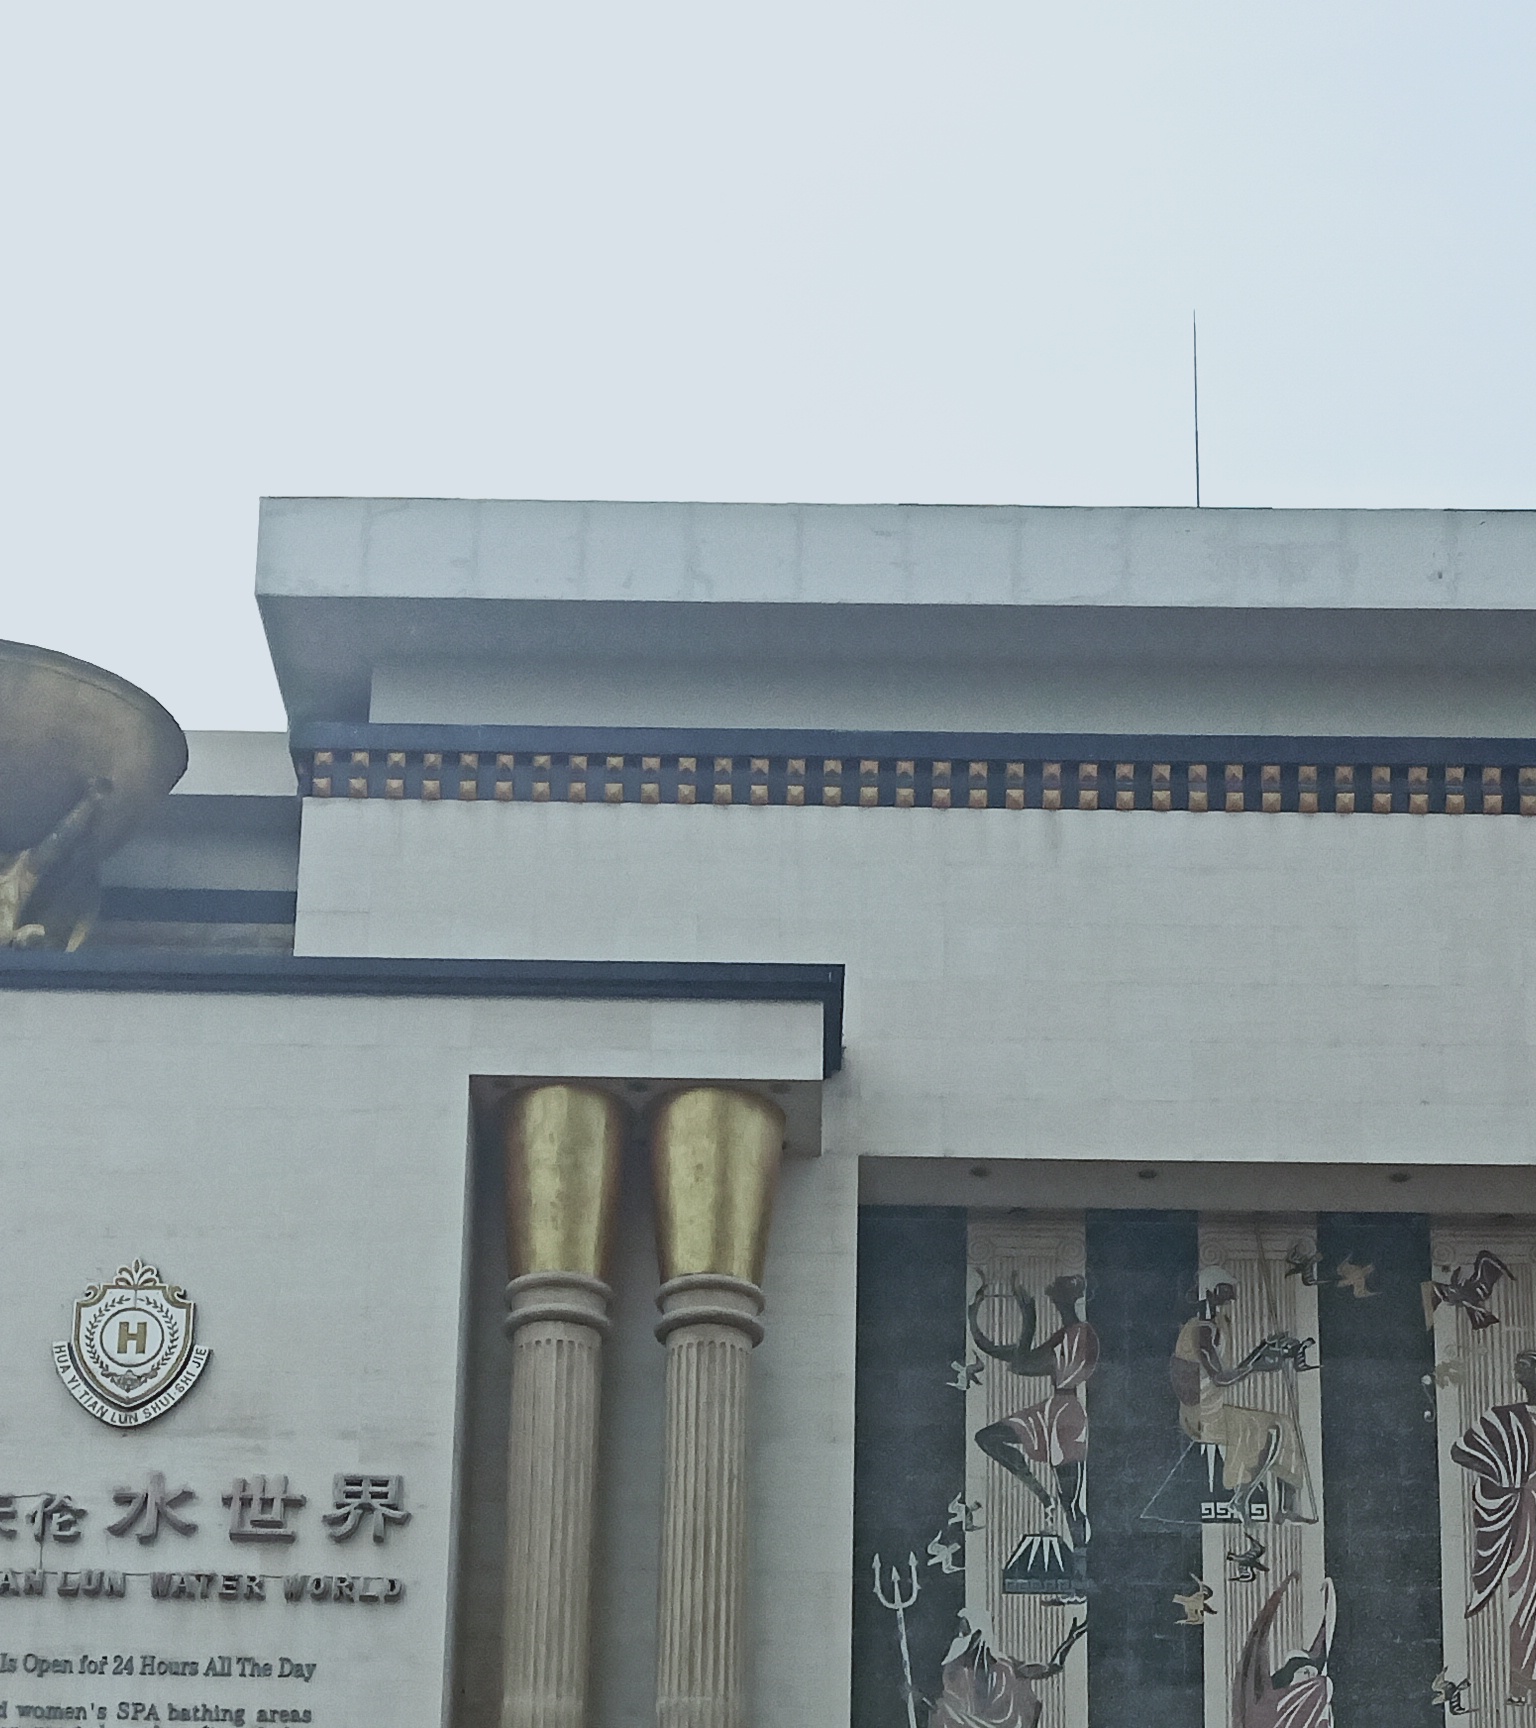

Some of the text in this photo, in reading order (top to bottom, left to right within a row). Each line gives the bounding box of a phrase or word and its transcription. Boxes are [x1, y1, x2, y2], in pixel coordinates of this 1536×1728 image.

[117, 1322, 147, 1354] H
[57, 1569, 126, 1598] LUN
[151, 1572, 265, 1601] WATER
[284, 1574, 404, 1602] WORLD
[23, 1653, 74, 1678] Open
[78, 1655, 108, 1675] for
[112, 1655, 134, 1675] 24
[139, 1655, 199, 1676] Hours
[203, 1656, 232, 1677] All
[236, 1656, 273, 1678] The
[277, 1656, 317, 1682] Day
[15, 1703, 107, 1720] women's
[116, 1702, 160, 1721] SPA
[168, 1703, 245, 1727] bathing
[256, 1708, 312, 1723] areas
